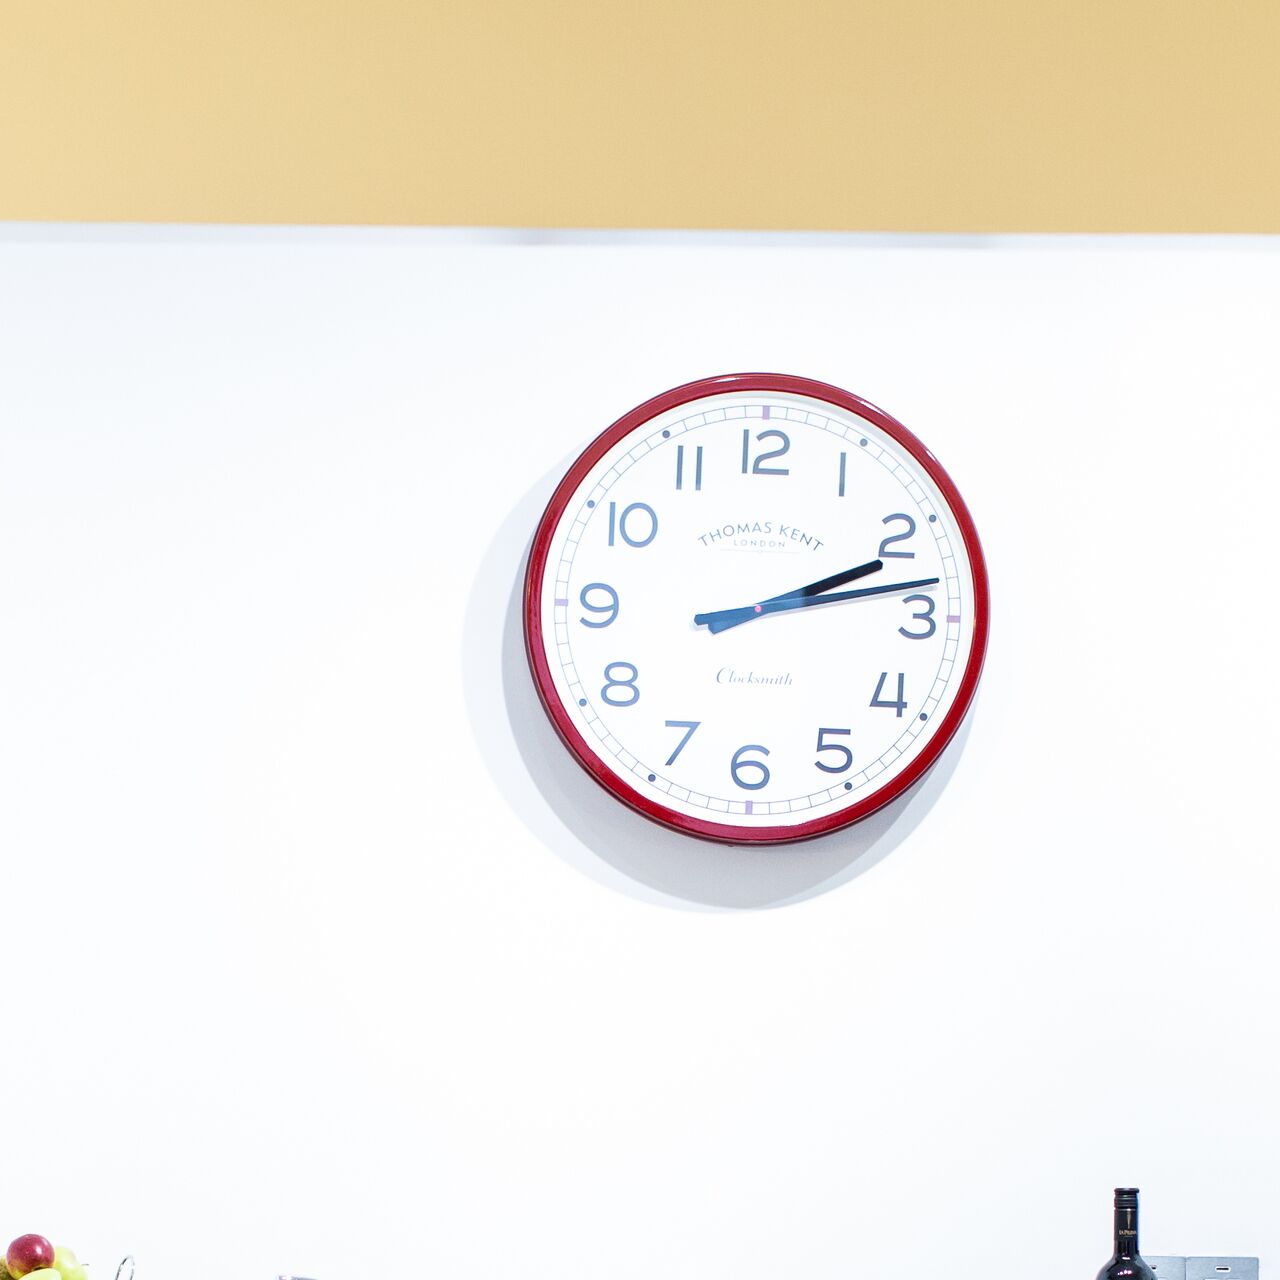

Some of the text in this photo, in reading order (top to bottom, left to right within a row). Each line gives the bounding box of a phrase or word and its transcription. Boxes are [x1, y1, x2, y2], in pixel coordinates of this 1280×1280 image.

[675, 444, 704, 491] 11
[741, 428, 791, 476] 12
[838, 451, 848, 498] 1
[607, 501, 659, 549] 10
[697, 521, 825, 551] THOMAS KENT
[733, 538, 786, 548] LONDON
[877, 512, 917, 560] 2
[579, 582, 620, 629] 9
[897, 593, 937, 641] 3
[600, 661, 641, 708] 8
[716, 667, 793, 686] Clocksmith
[868, 671, 908, 719] 4
[664, 719, 702, 767] 7
[814, 727, 854, 774] 5
[730, 744, 771, 791] 6
